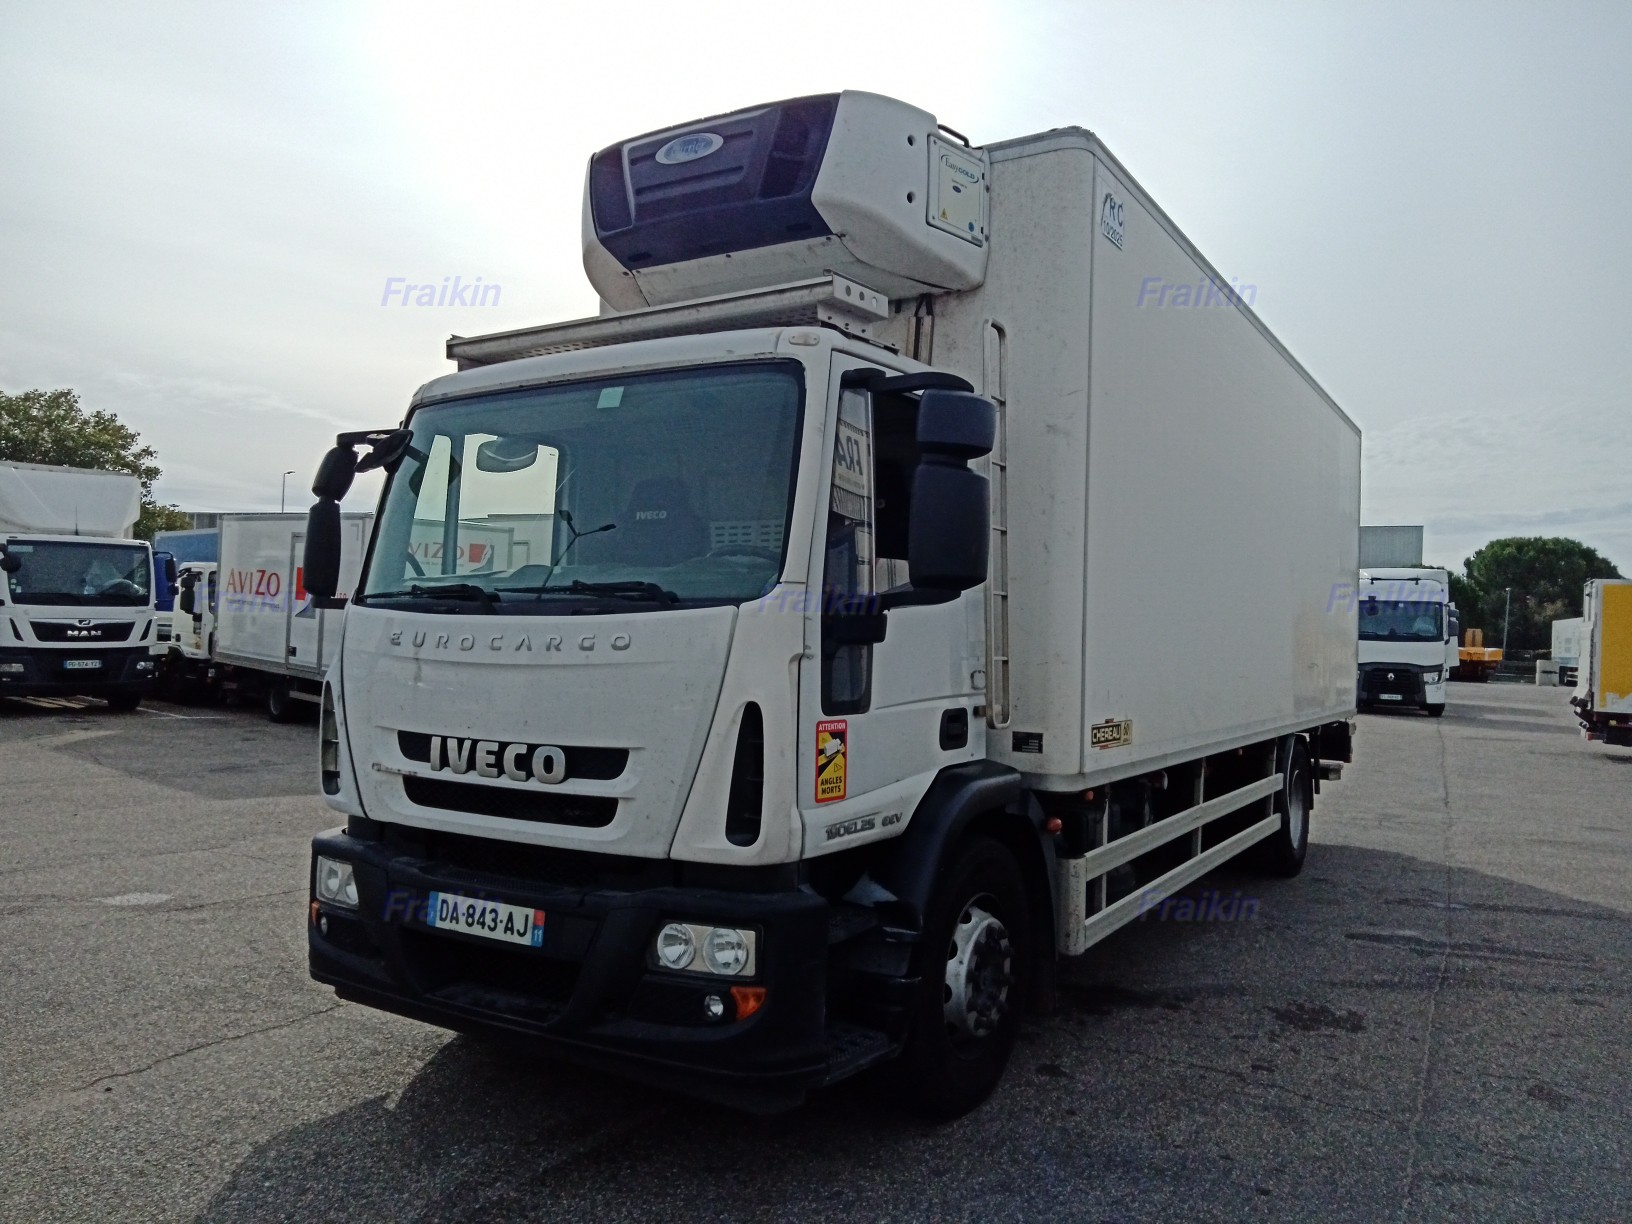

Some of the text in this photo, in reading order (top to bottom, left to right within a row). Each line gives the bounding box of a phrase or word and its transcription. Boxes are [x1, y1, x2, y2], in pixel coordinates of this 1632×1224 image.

[636, 510, 667, 520] IVECO
[226, 568, 280, 597] AVIZO
[390, 631, 632, 651] EUROCARGO
[819, 722, 846, 731] ATTENTION
[1092, 726, 1121, 743] CHEREAU
[430, 736, 566, 784] IVECO
[820, 776, 842, 787] ANGLES
[821, 785, 841, 795] MORTS
[438, 898, 530, 938] DA-843-AJ
